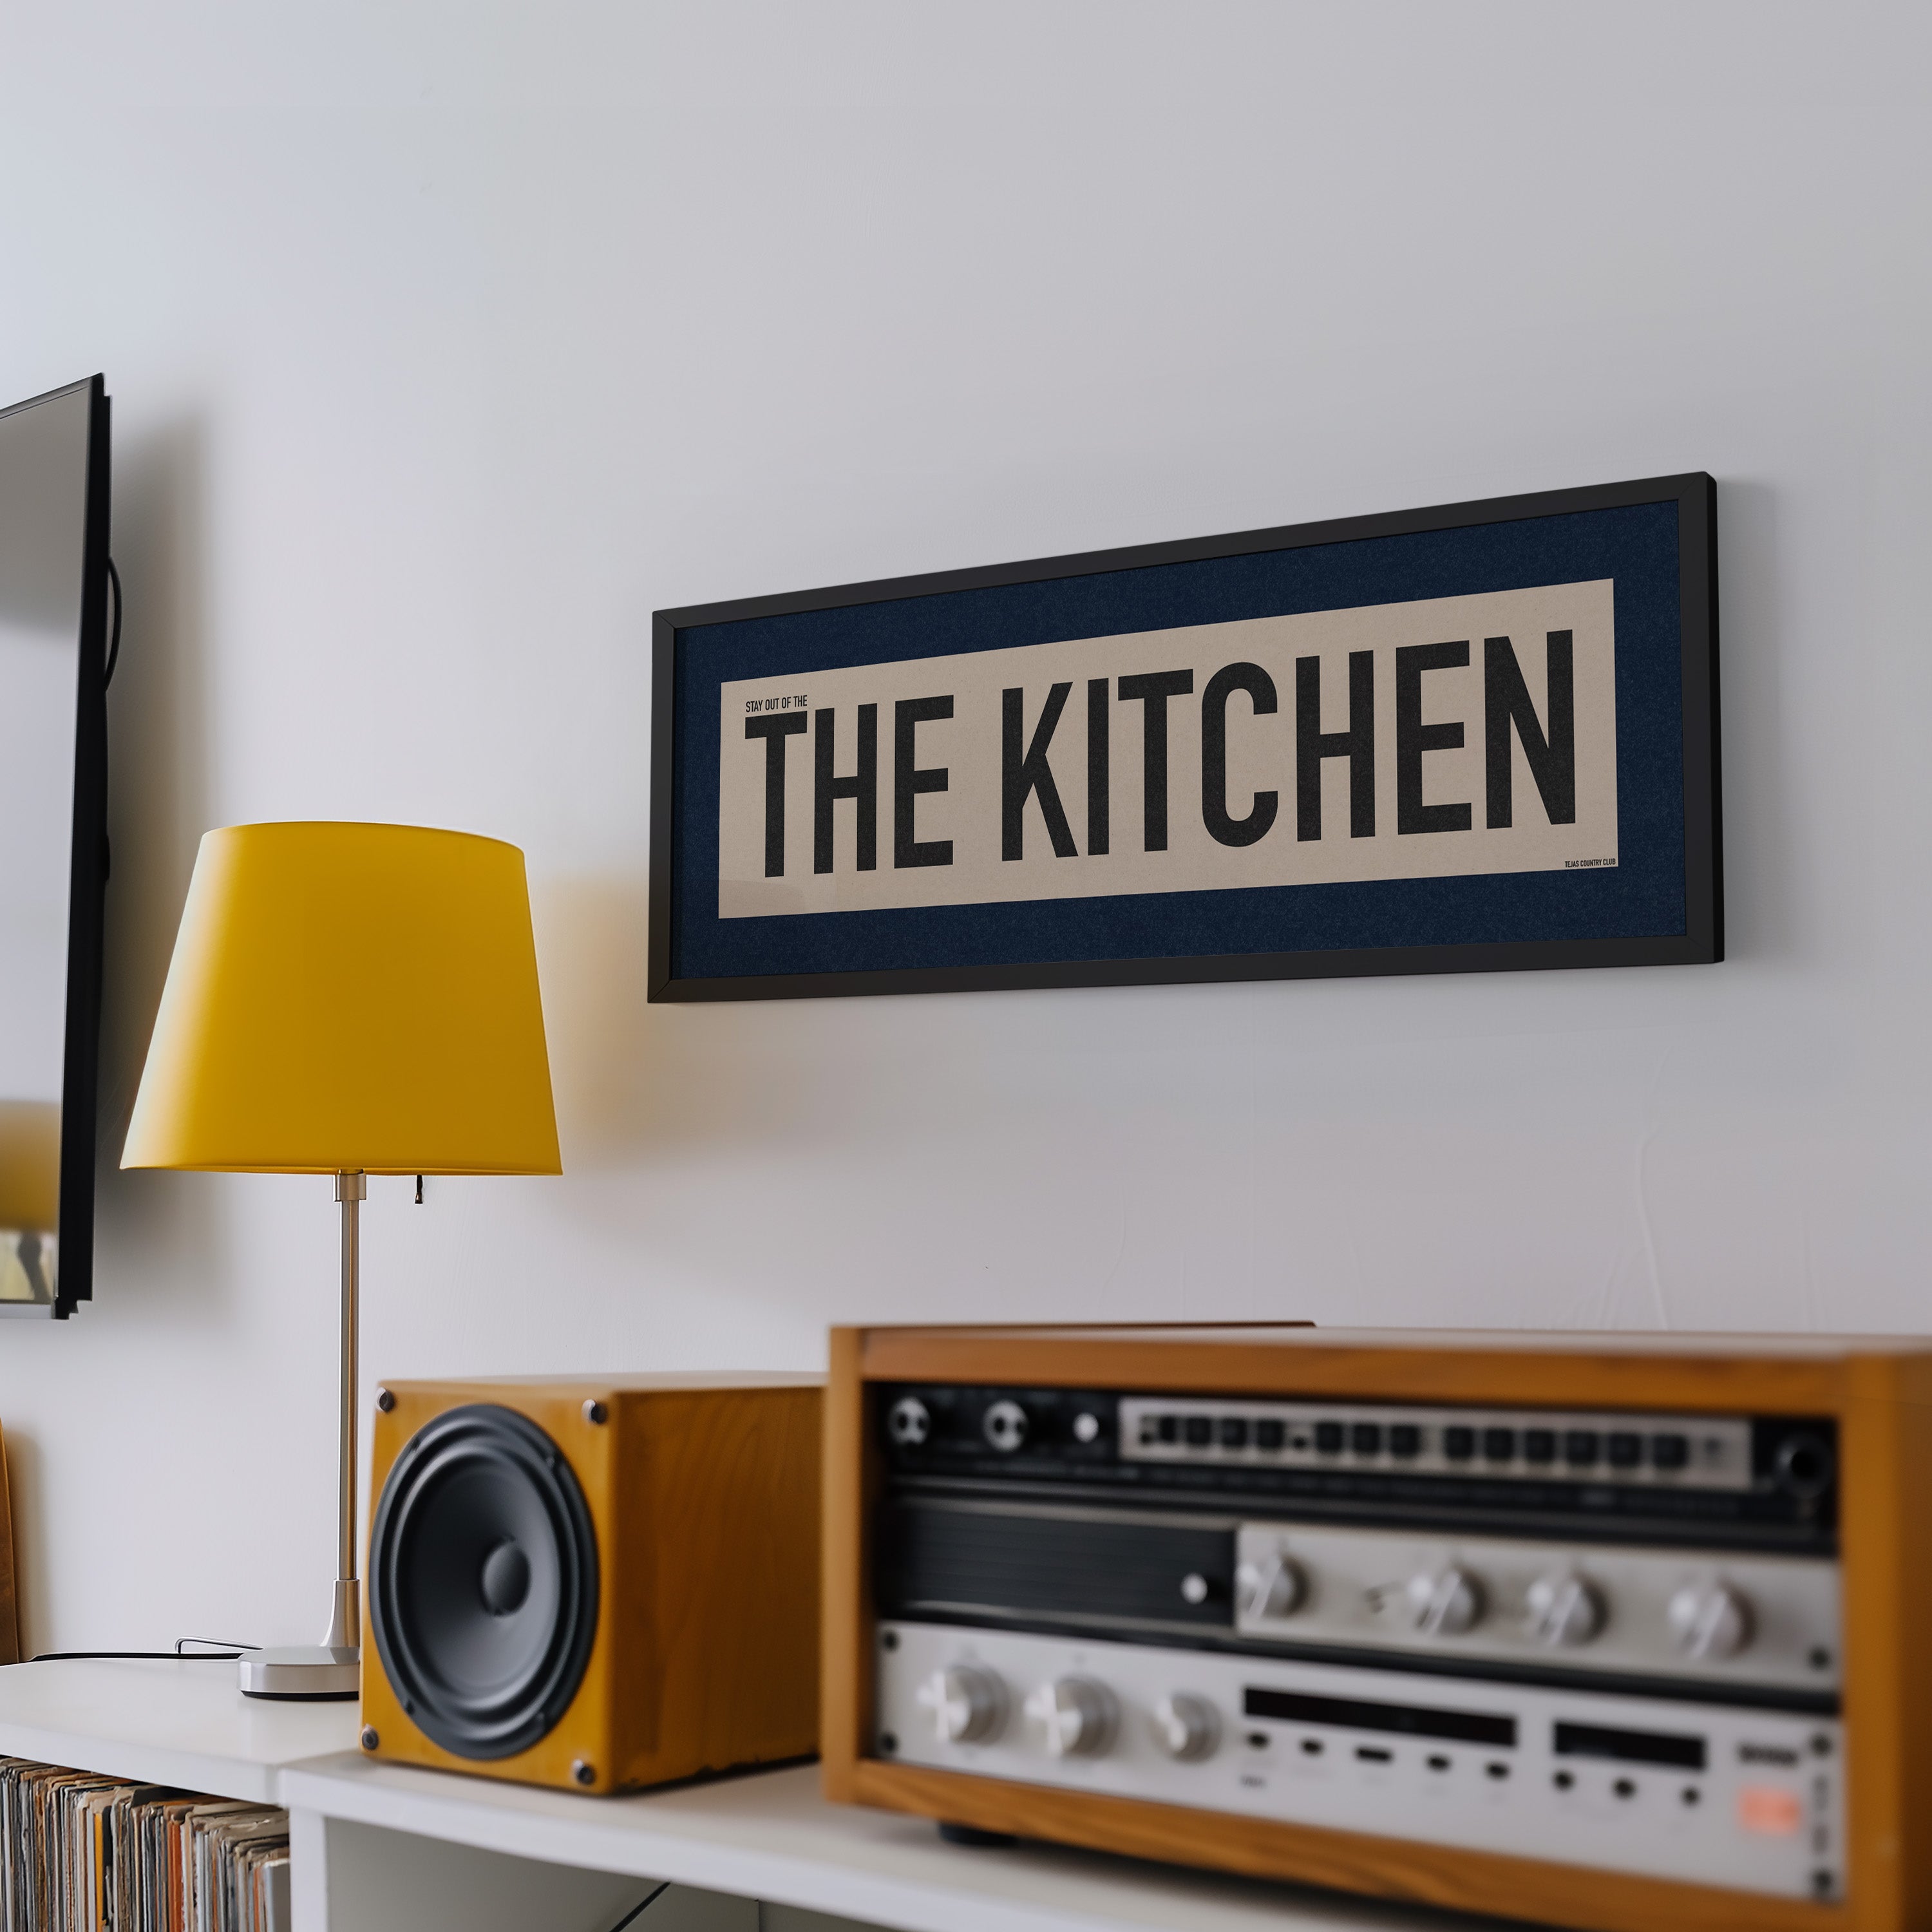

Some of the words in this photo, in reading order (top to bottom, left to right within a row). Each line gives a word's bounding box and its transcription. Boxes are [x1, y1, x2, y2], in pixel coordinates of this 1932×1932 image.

[745, 695, 954, 877] THE
[1002, 629, 1575, 861] KITCHEN
[746, 699, 763, 712] STAY
[765, 697, 779, 710] OUT
[781, 696, 791, 708] OF
[793, 695, 808, 707] THE
